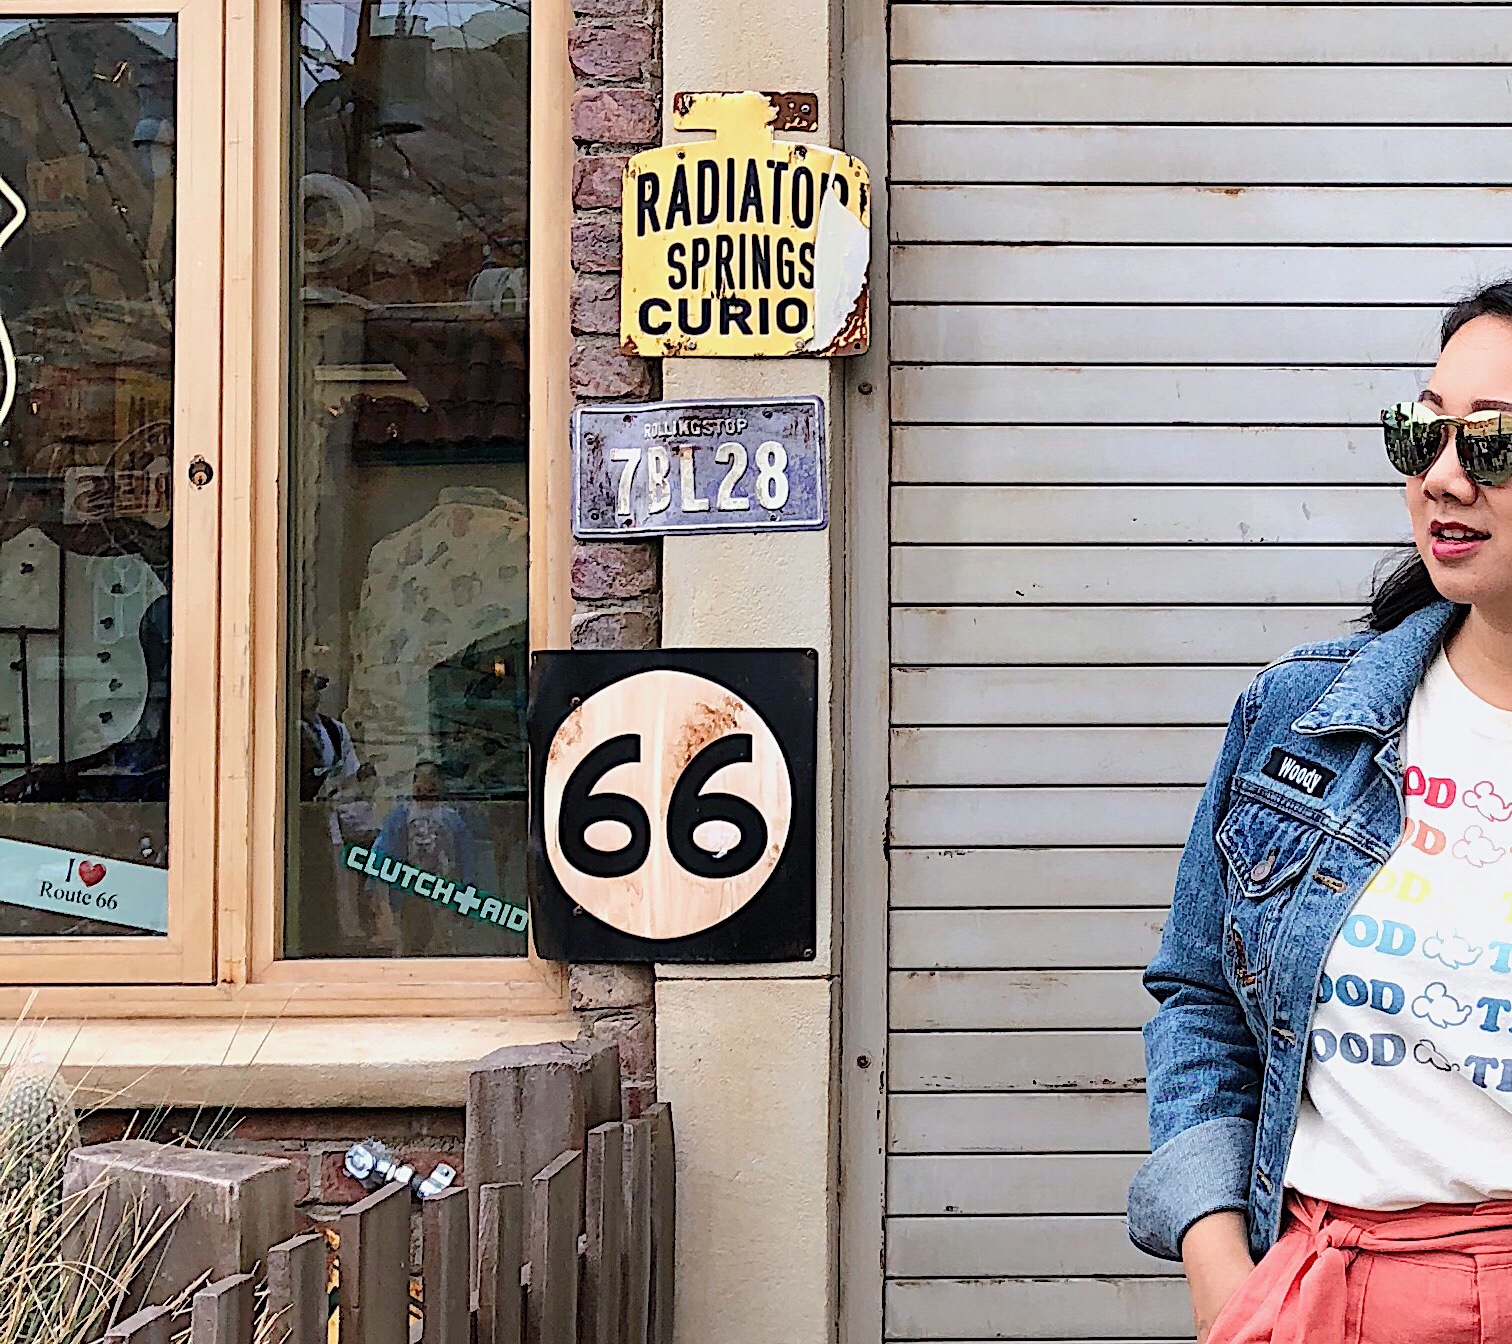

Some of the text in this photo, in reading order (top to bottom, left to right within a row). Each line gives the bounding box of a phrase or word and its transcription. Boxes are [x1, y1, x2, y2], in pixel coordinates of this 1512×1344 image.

[667, 233, 815, 290] SPRINGS
[638, 296, 809, 336] CURIO
[610, 441, 790, 516] 7BL28
[1277, 756, 1322, 794] Woody
[559, 733, 767, 878] 66
[39, 879, 119, 911] Route 66
